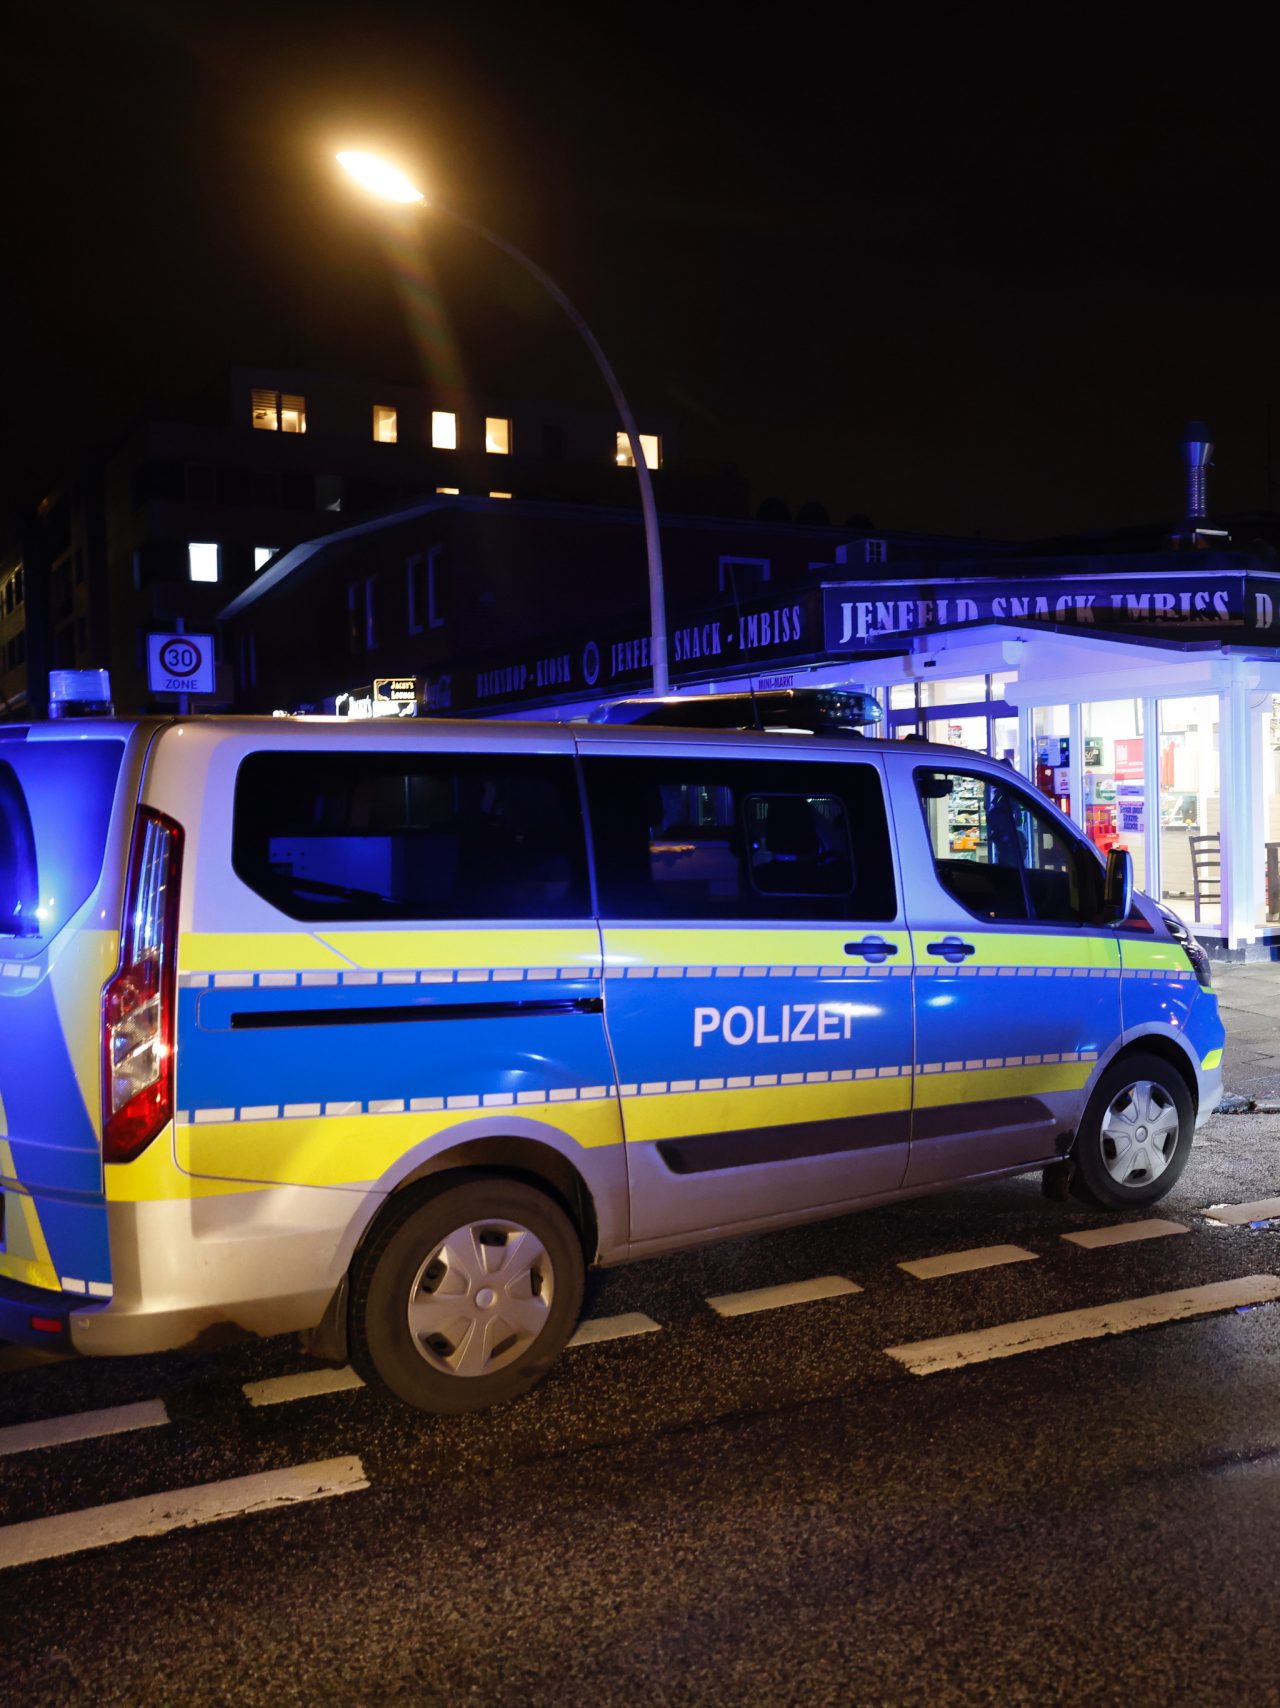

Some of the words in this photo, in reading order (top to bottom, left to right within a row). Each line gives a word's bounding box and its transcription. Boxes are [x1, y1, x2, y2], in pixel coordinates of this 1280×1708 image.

[839, 598, 978, 643] JENFELD
[992, 595, 1096, 623] SNACK
[1110, 591, 1230, 622] IMBISS
[610, 636, 653, 679] JENFE
[673, 621, 722, 662] SNACK
[739, 604, 800, 650] IMBISS
[168, 649, 193, 667] 30
[165, 679, 198, 690] ZONE
[758, 675, 794, 690] MINI-MARKT
[693, 1003, 852, 1047] POLIZEI
